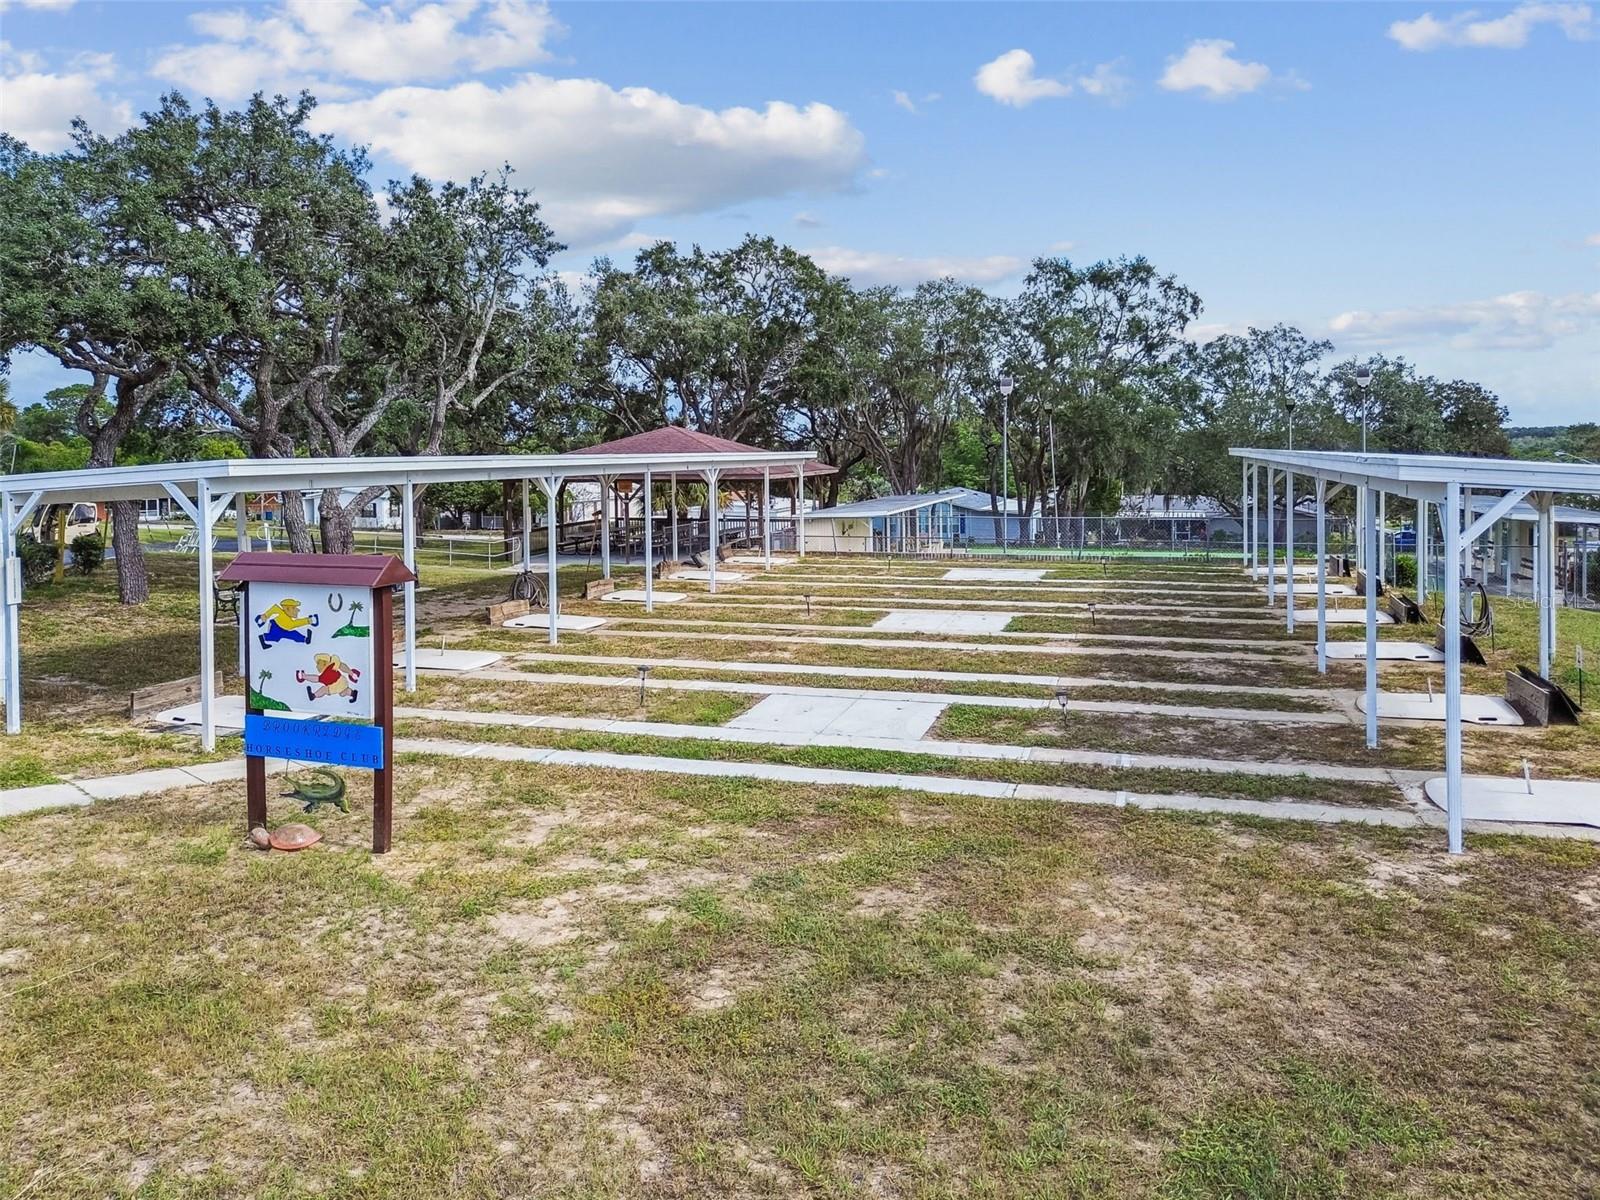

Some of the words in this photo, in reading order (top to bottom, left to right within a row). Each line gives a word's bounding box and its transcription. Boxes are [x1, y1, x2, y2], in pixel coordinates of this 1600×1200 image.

[263, 720, 361, 740] BROOKRIDGE
[246, 744, 332, 760] HORSESHOE
[340, 751, 379, 764] CLUB
